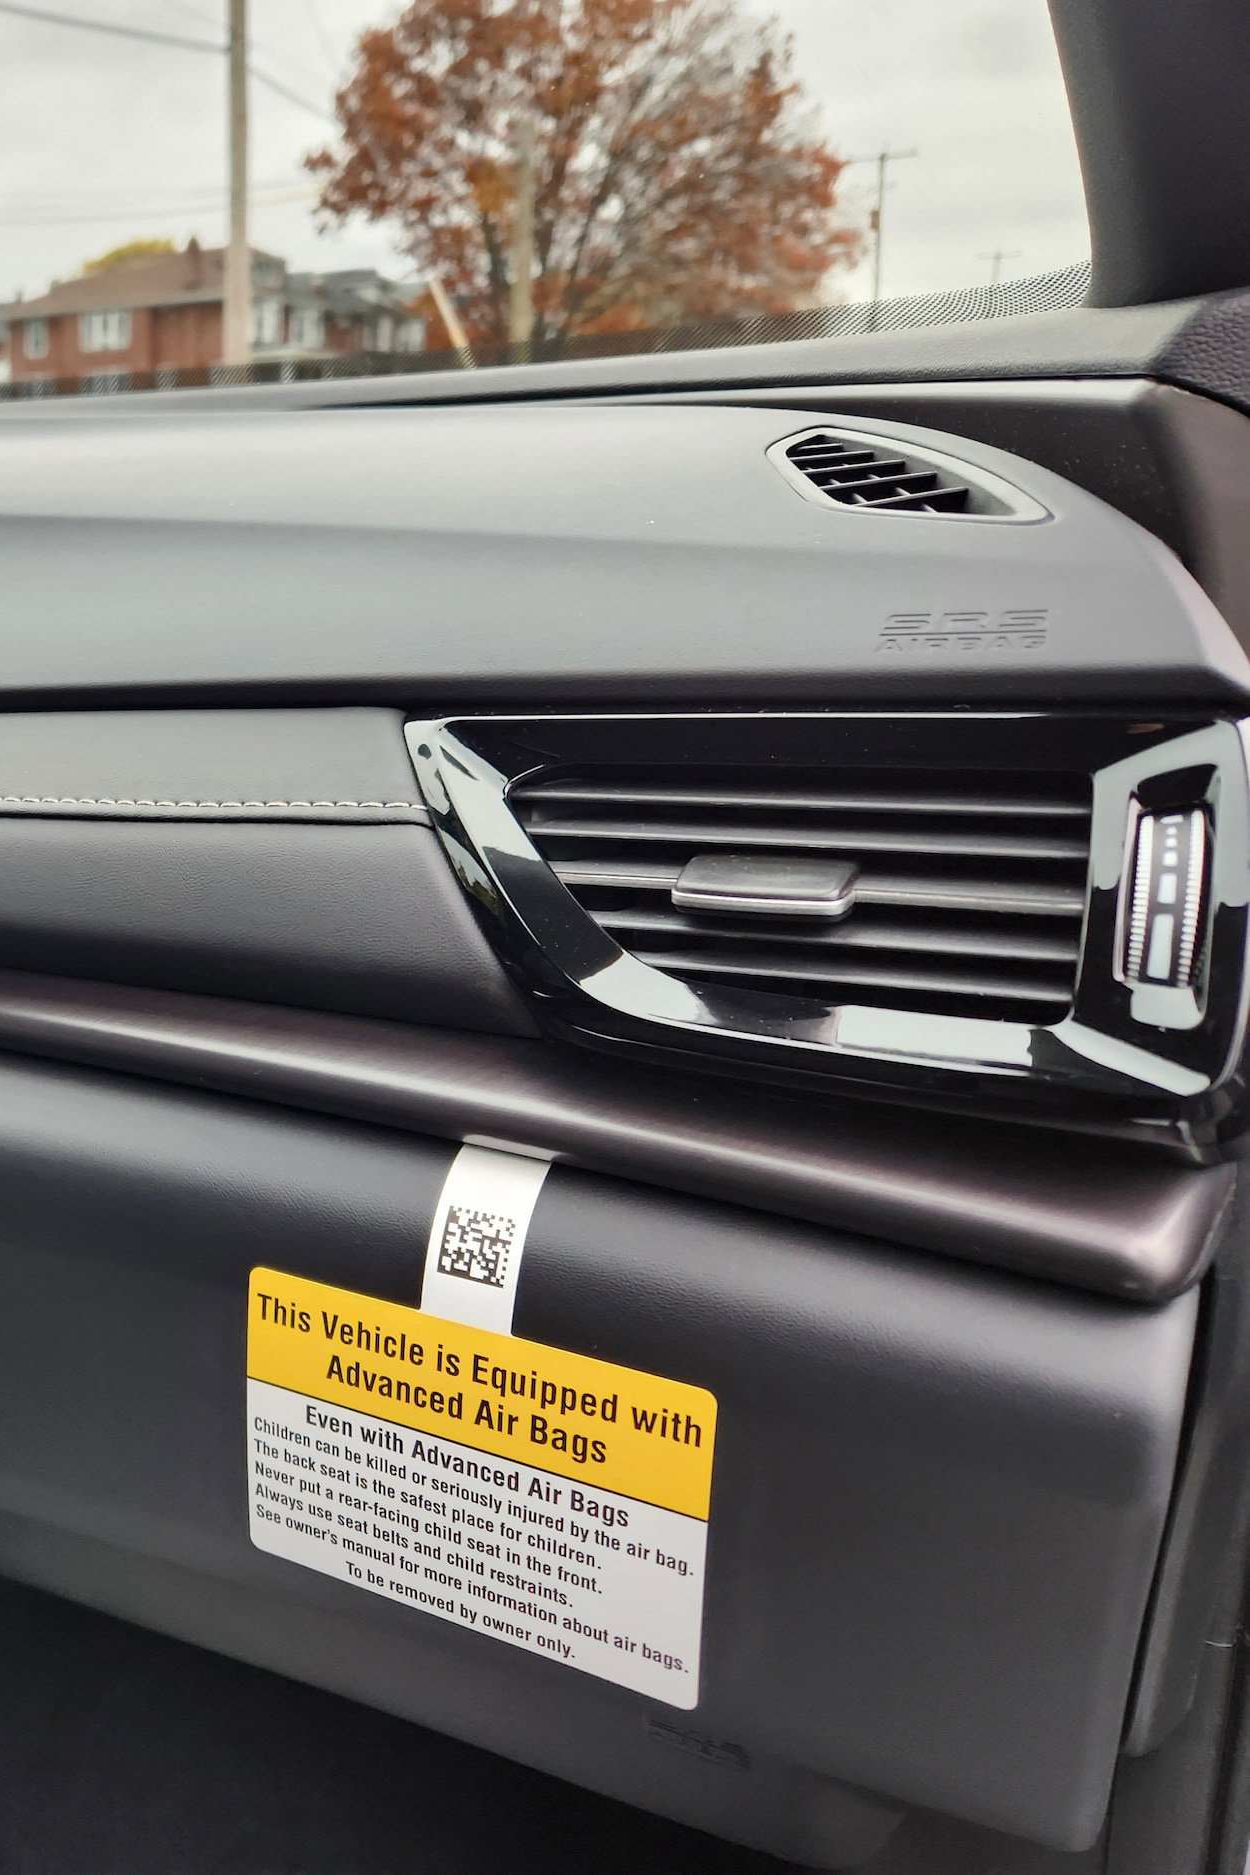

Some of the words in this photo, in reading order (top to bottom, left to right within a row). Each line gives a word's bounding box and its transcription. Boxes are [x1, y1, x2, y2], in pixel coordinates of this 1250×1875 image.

[884, 609, 1049, 630] SRS
[257, 1292, 311, 1333] This
[321, 1310, 424, 1366] Vehicle
[436, 1343, 461, 1377] is
[471, 1353, 618, 1424] Equipped
[631, 1406, 702, 1448] with
[326, 1354, 463, 1420] Advanced
[474, 1399, 519, 1436] Air
[530, 1414, 607, 1464] Bags
[253, 1438, 279, 1459] The
[284, 1448, 316, 1473] back
[320, 1464, 351, 1484] seat
[355, 1472, 368, 1490] is
[372, 1478, 396, 1499] the
[400, 1491, 447, 1517] safest
[451, 1508, 494, 1533] place
[499, 1522, 523, 1542] for
[527, 1533, 602, 1570] children.
[254, 1416, 311, 1448] Children
[315, 1439, 340, 1458] can
[344, 1445, 362, 1465] be
[366, 1452, 407, 1480] killed
[411, 1471, 428, 1486] or
[431, 1478, 503, 1514] seriously
[507, 1499, 565, 1533] injured
[570, 1520, 589, 1543] by
[594, 1529, 621, 1551] the
[626, 1542, 651, 1560] air
[656, 1548, 693, 1576] bag.
[255, 1460, 295, 1486] Never
[299, 1478, 321, 1496] put
[325, 1488, 334, 1500] a
[338, 1492, 419, 1533] rear-facing
[424, 1521, 462, 1546] child
[466, 1537, 501, 1559] seat
[506, 1547, 521, 1566] in
[525, 1555, 552, 1576] the
[557, 1565, 602, 1594] front.
[306, 1404, 353, 1438] Even
[359, 1426, 404, 1455] with
[411, 1439, 519, 1493] Advanced
[527, 1477, 562, 1505] Air
[570, 1489, 629, 1527] Bags
[255, 1483, 304, 1511] Always
[308, 1503, 333, 1522] use
[337, 1514, 369, 1535] seat
[372, 1523, 409, 1549] belts
[413, 1541, 441, 1561] and
[446, 1552, 485, 1576] child
[490, 1568, 573, 1608] restraints.
[256, 1503, 281, 1524] See
[342, 1537, 395, 1566] manual
[399, 1555, 420, 1575] for
[424, 1567, 462, 1590] more
[467, 1579, 557, 1625] information
[562, 1617, 609, 1644] about
[614, 1636, 637, 1653] air
[642, 1643, 690, 1674] bags.
[345, 1560, 362, 1579] To
[367, 1568, 384, 1587] be
[389, 1580, 455, 1614] removed
[459, 1603, 478, 1625] by
[482, 1615, 532, 1642] owner
[536, 1635, 575, 1659] only.
